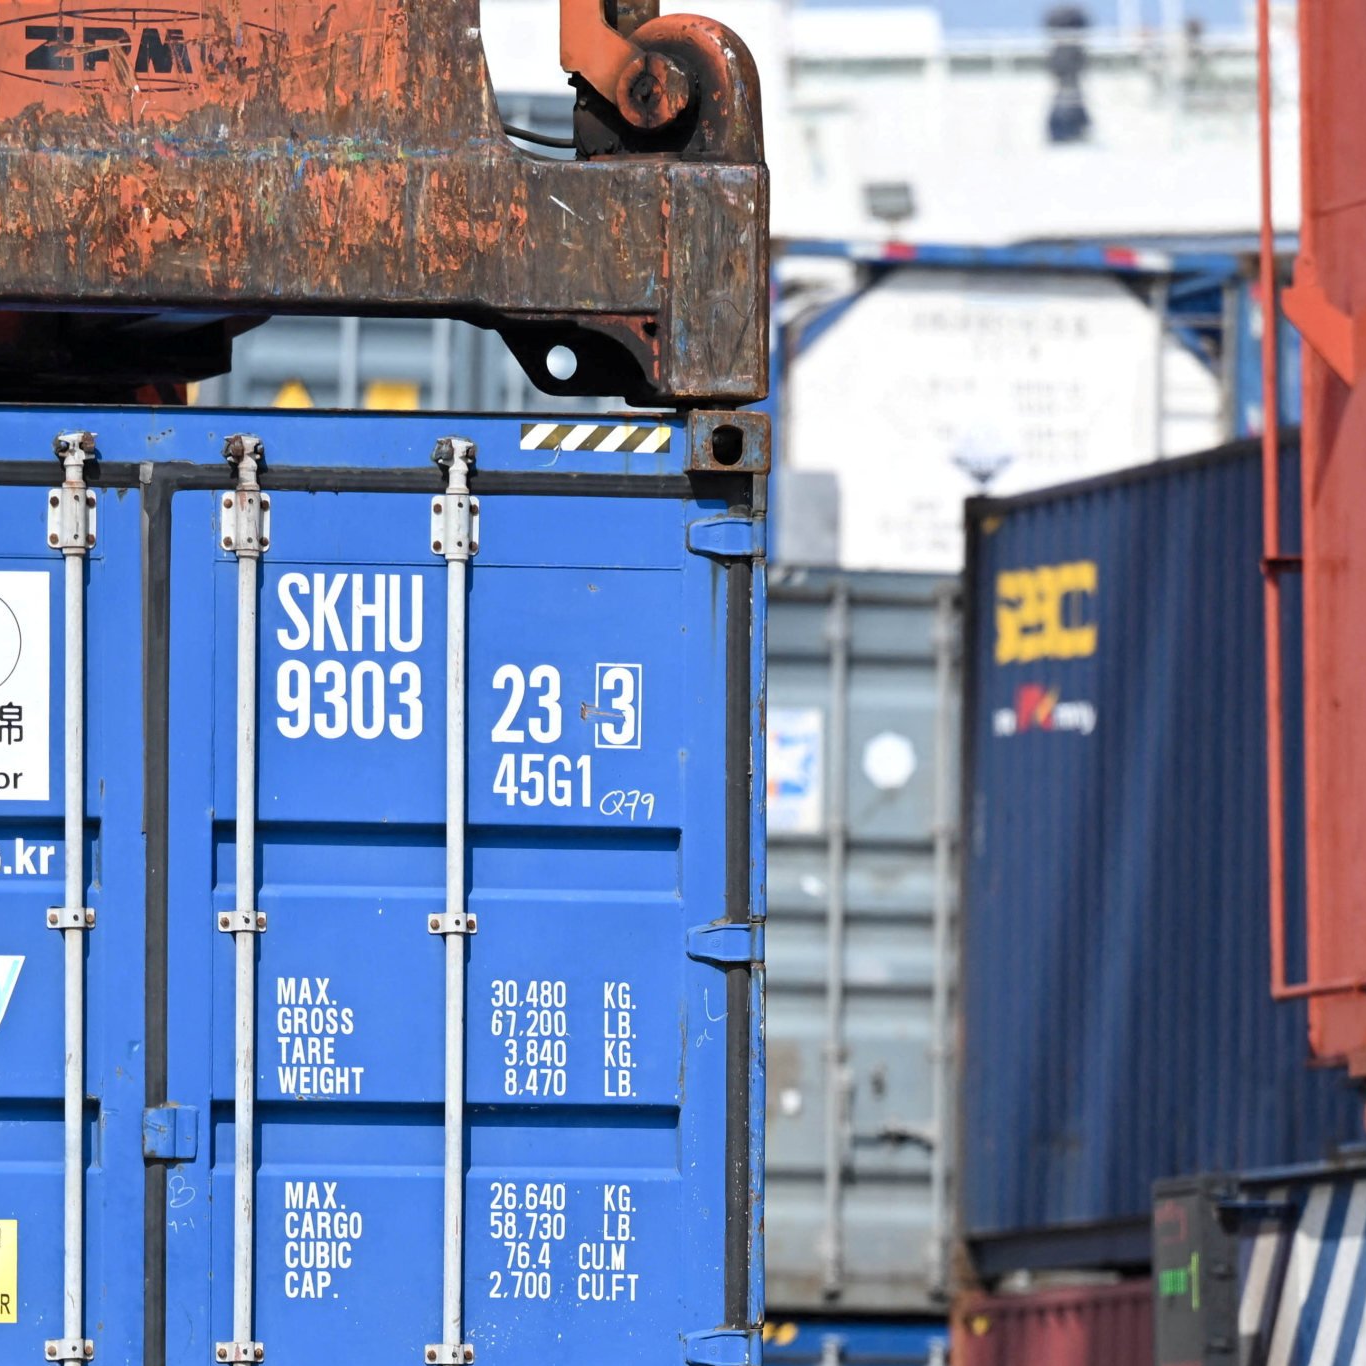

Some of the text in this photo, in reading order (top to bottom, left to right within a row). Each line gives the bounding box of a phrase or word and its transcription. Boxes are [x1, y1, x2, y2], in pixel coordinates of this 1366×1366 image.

[25, 25, 227, 75] ZPM
[277, 573, 423, 652] SKHU
[277, 660, 635, 746] 9303 23 3
[493, 754, 591, 808] 45G1
[278, 978, 636, 1009] MAX. 30,480 KG.
[278, 1007, 636, 1038] GROSS 67,200 LB.
[278, 1037, 636, 1067] TARE 3,840 KG.
[278, 1067, 636, 1097] WEIGHT 8,470 LB.
[285, 1182, 636, 1211] MAX. 26,640 KG.
[285, 1212, 635, 1241] CARGO 58,730 LB.
[285, 1242, 625, 1270] CUBIC 76.4 CU.M
[285, 1271, 638, 1301] CAP. 2,700 CU.FT
